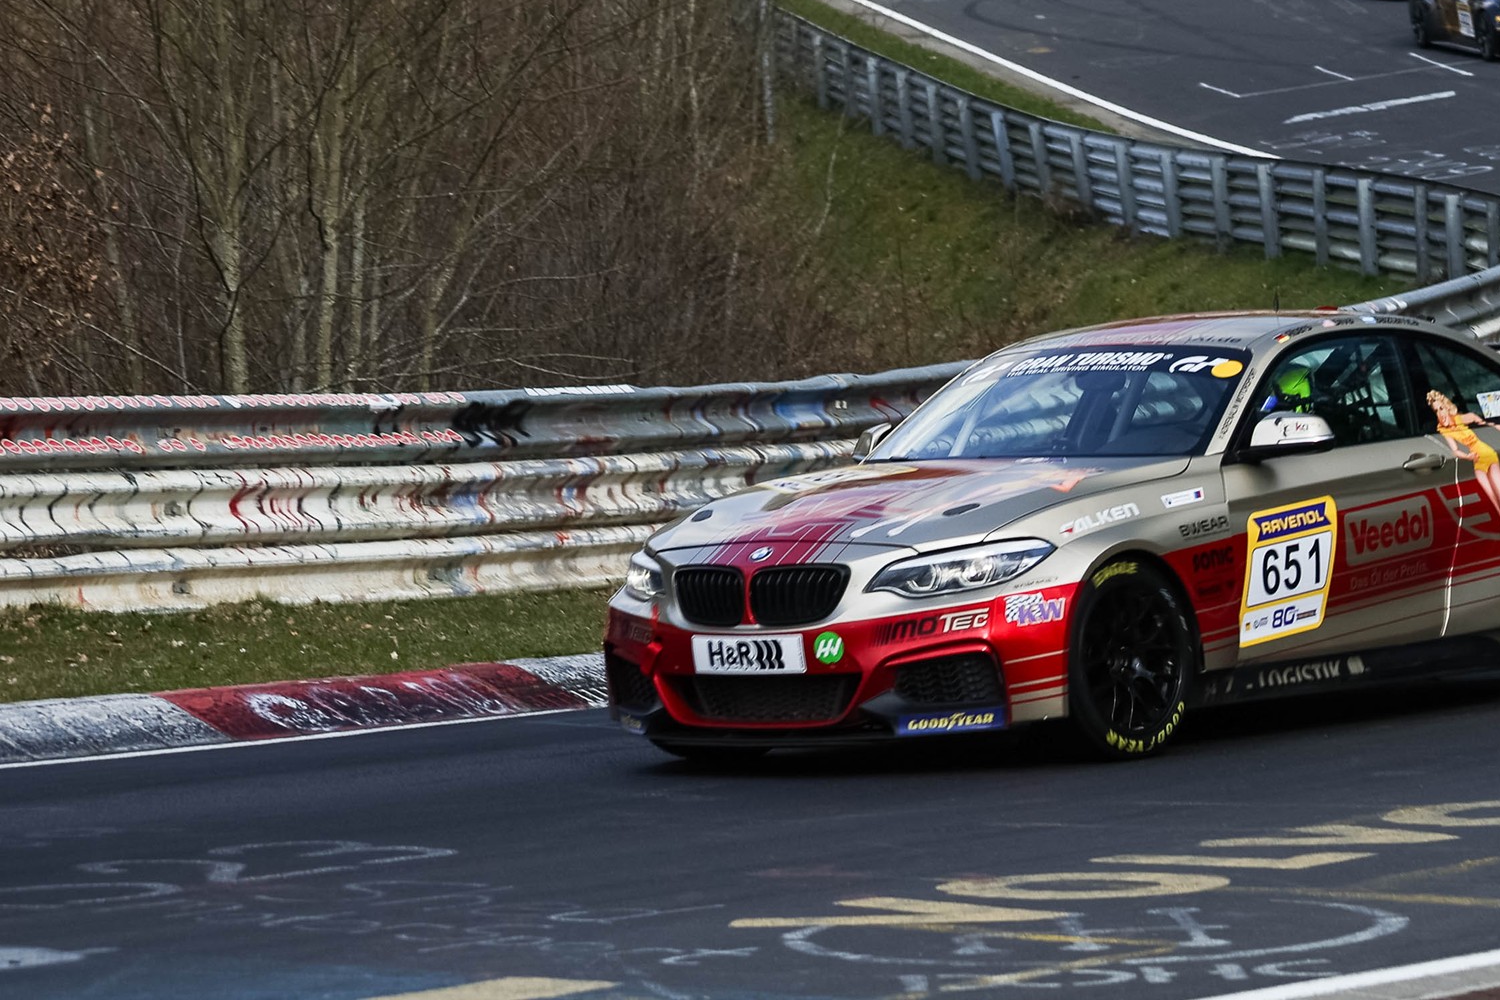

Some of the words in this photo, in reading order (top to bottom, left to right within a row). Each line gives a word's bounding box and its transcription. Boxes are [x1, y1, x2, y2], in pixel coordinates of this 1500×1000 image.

[1010, 352, 1071, 373] GRAN
[1022, 368, 1049, 377] REAL
[1049, 366, 1091, 375] DRIVING
[1090, 364, 1148, 373] SIMULATOR
[1059, 502, 1141, 537] FALKEN
[1260, 509, 1325, 537] RAVENOL
[1349, 504, 1431, 555] Veedol
[1262, 537, 1322, 596] 651
[1351, 574, 1369, 590] Das
[1382, 566, 1399, 583] der
[1017, 597, 1066, 627] KW
[907, 711, 995, 732] GOODYEAR
